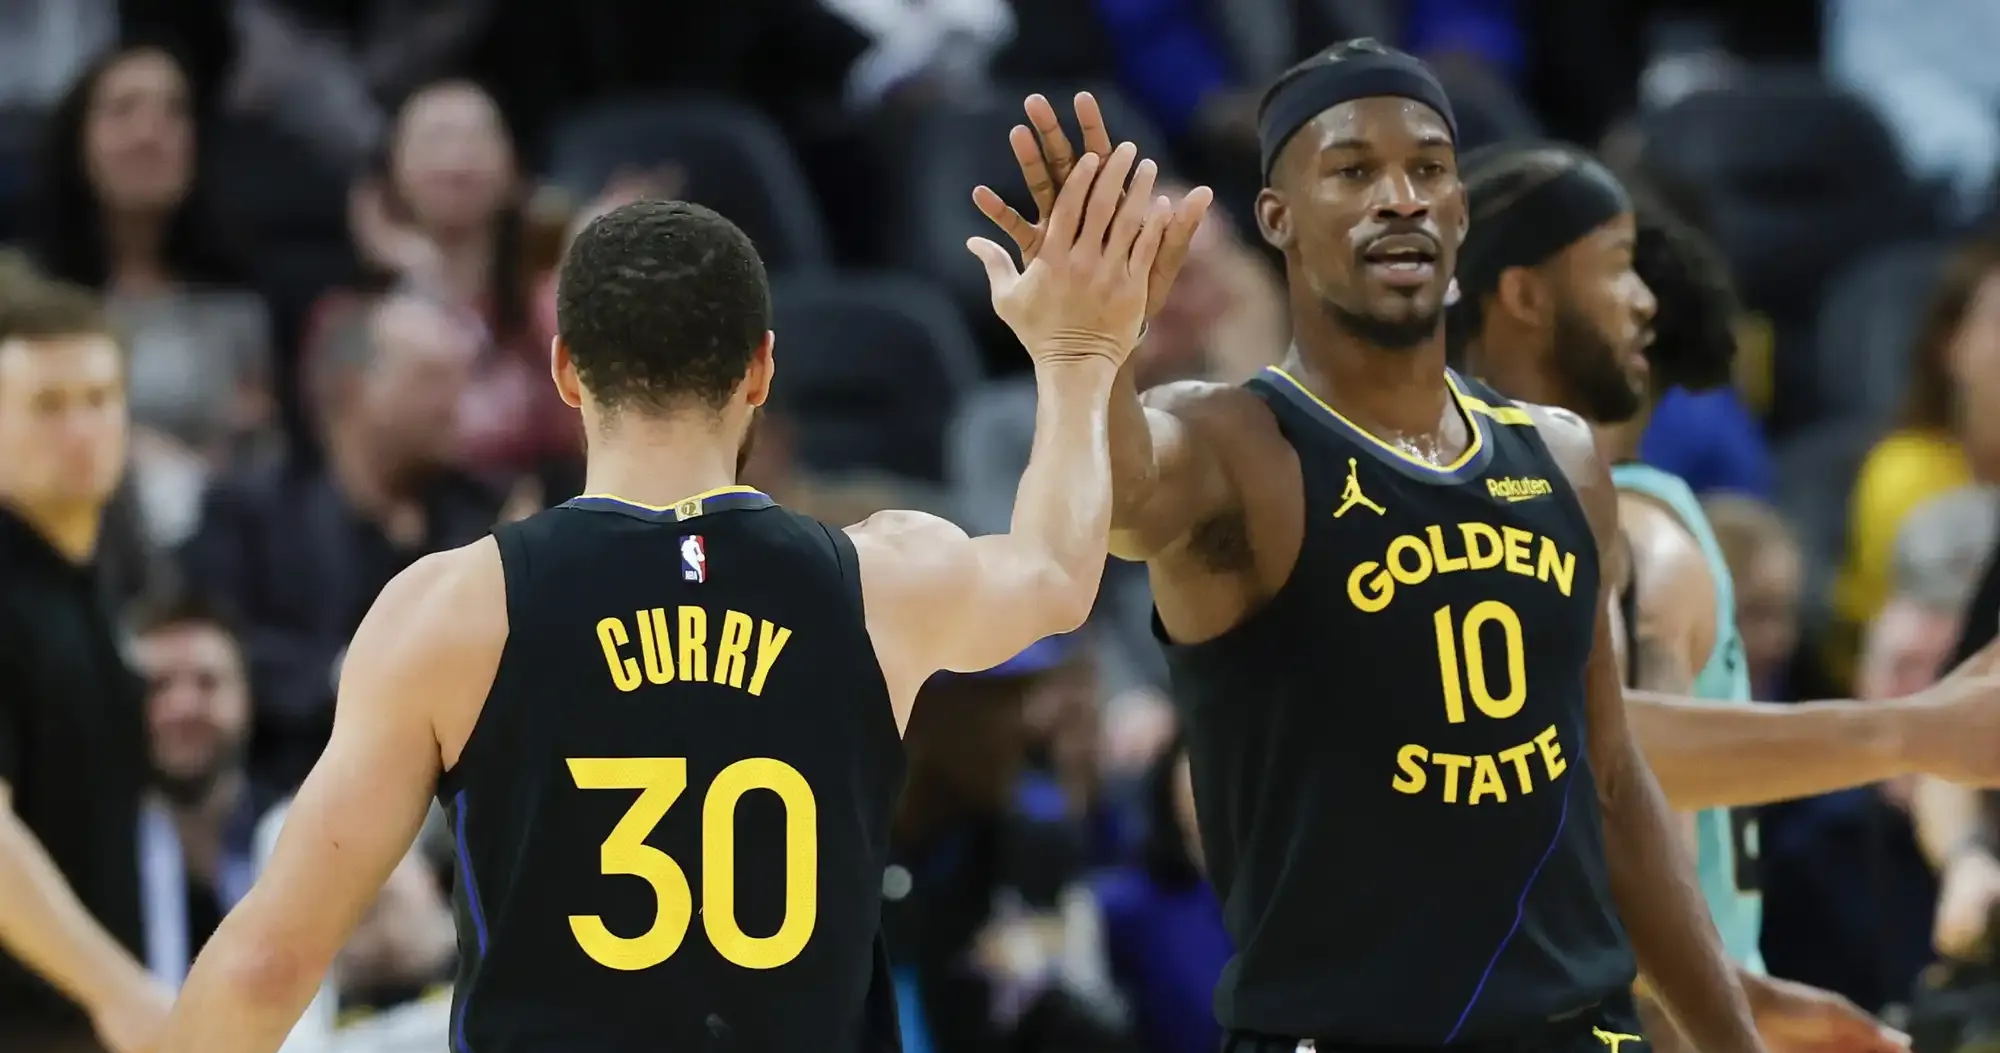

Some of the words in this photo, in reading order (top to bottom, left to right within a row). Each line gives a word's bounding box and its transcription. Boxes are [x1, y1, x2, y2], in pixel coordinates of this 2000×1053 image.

[1486, 476, 1552, 498] Rakuten
[1347, 523, 1576, 612] GOLDEN
[597, 606, 792, 696] CURRY
[1434, 600, 1527, 724] 10
[1392, 724, 1567, 805] STATE
[566, 757, 817, 970] 30
